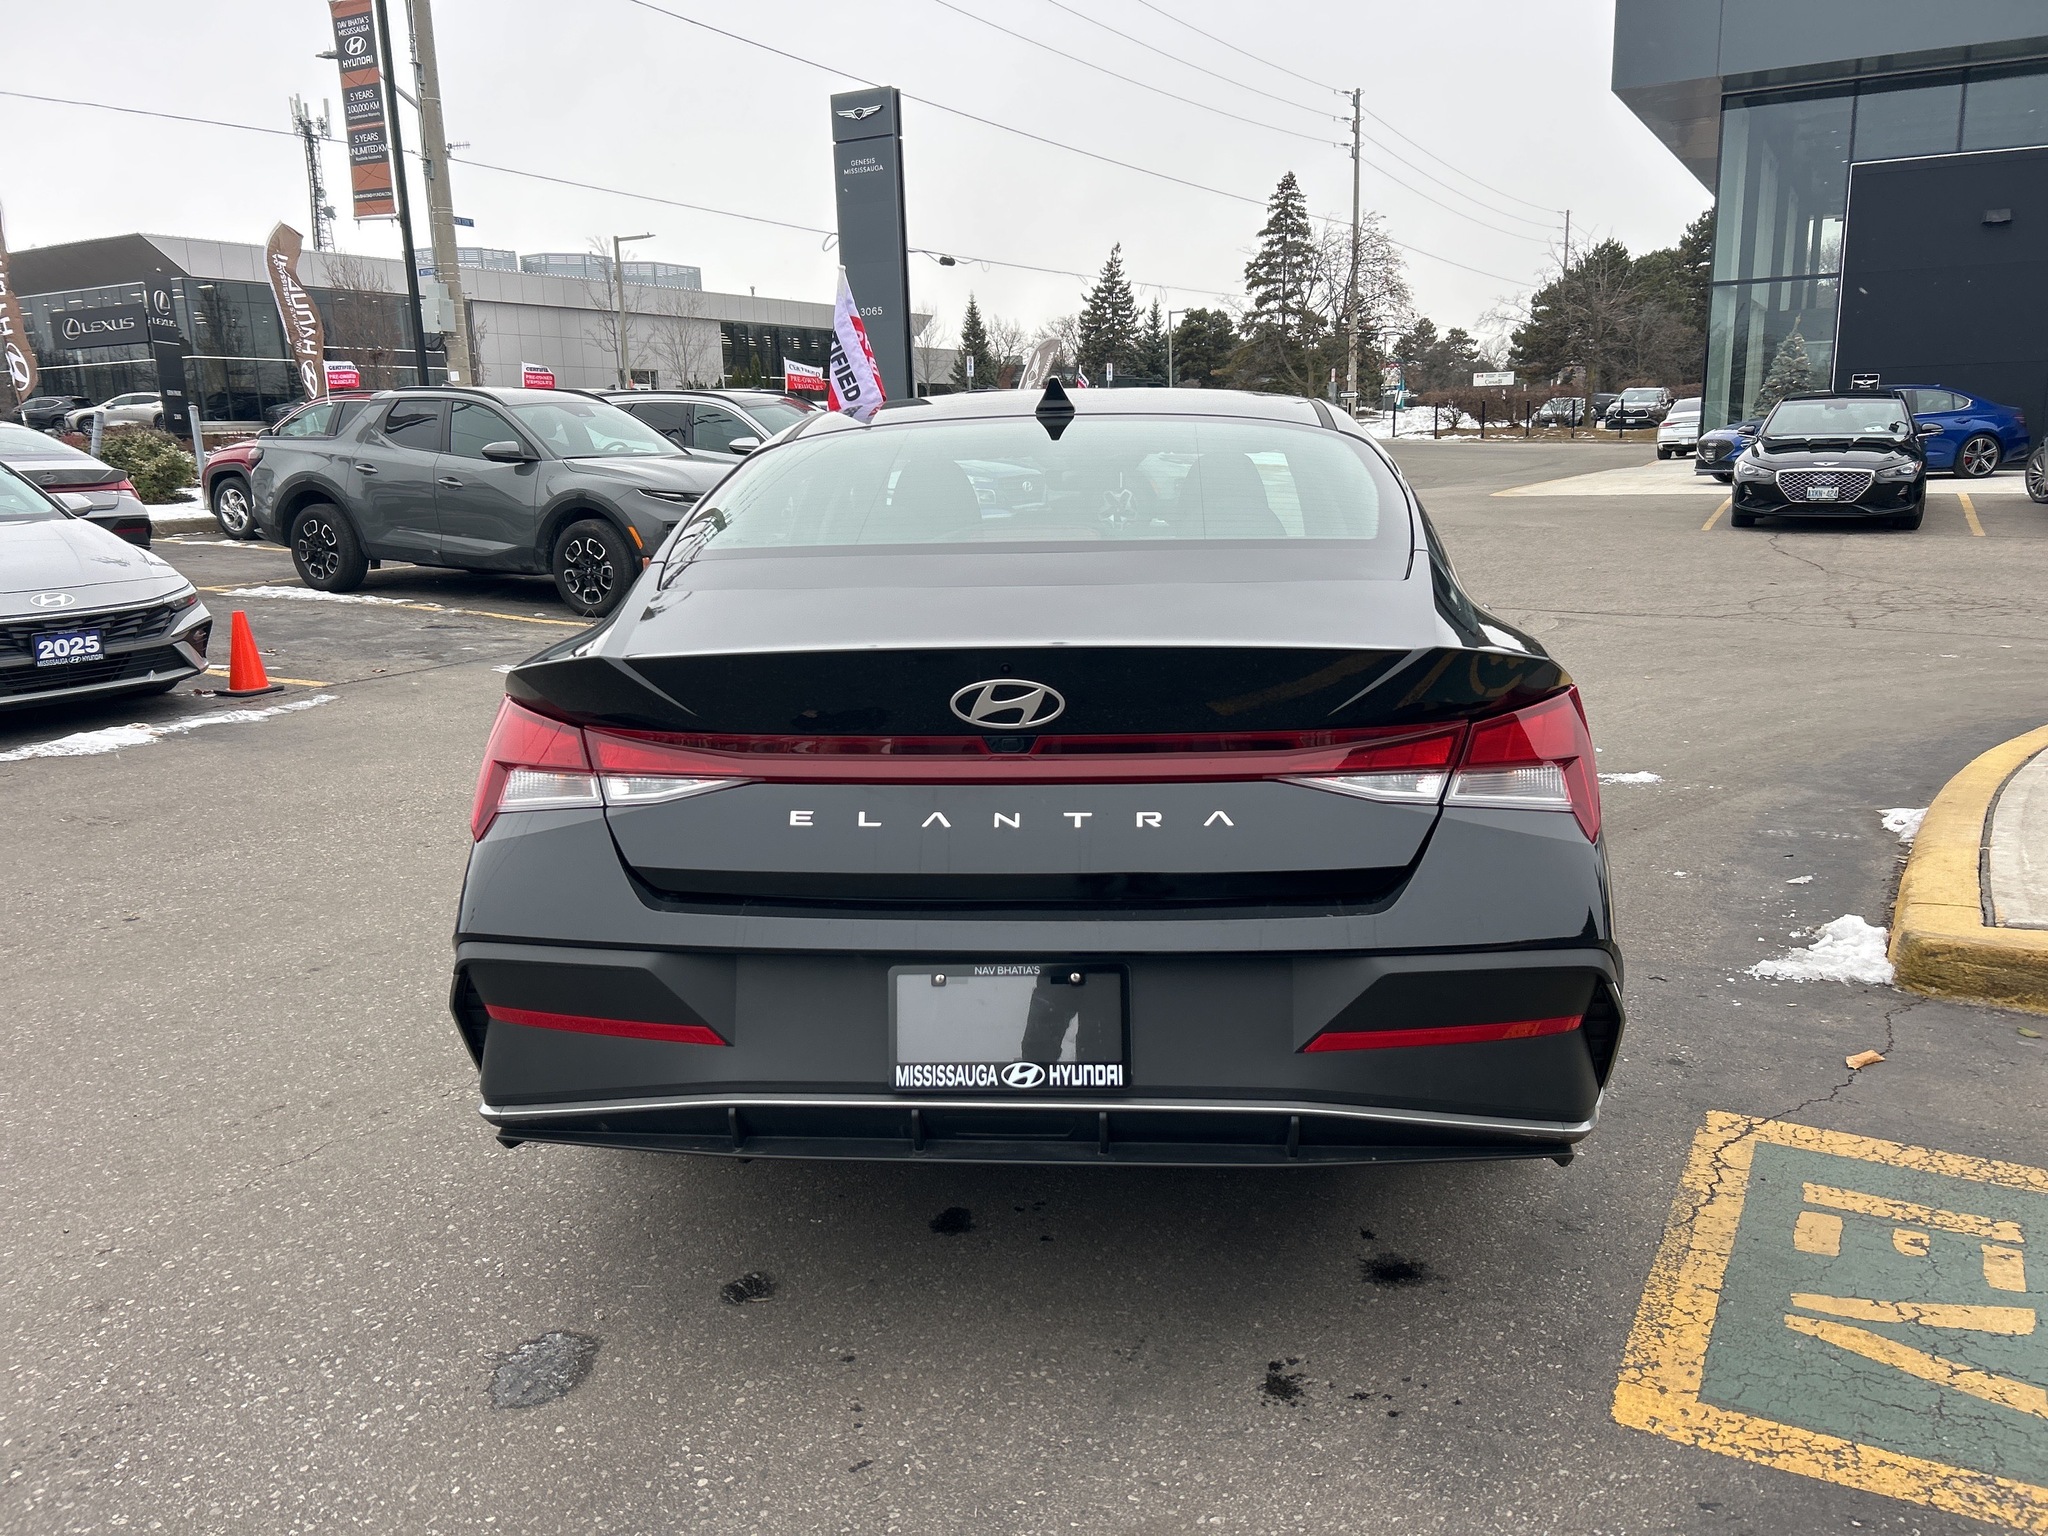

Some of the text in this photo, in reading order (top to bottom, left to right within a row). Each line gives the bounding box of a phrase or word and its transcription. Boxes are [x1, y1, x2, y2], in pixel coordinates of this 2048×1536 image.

[337, 19, 348, 29] NAV
[338, 24, 370, 36] MISSISSAUGA
[342, 55, 374, 68] HYUNDAI
[350, 89, 374, 102] 5 YEARS
[347, 101, 380, 114] 100,000 KM
[354, 132, 379, 144] 5 YEARS
[850, 157, 876, 167] GENESIS
[843, 164, 884, 175] MISSISSAUGA
[860, 306, 883, 317] 3065
[81, 317, 135, 334] LEXUS
[151, 316, 177, 328] LEXUS
[38, 635, 100, 659] 2025
[37, 653, 104, 667] MISSISSAUGA HYUNDAI
[789, 810, 1235, 828] ELANTRA
[974, 965, 1041, 975] NAV BHATIA'S
[895, 1064, 1123, 1087] MISSISSAUGA HYUNDAI
